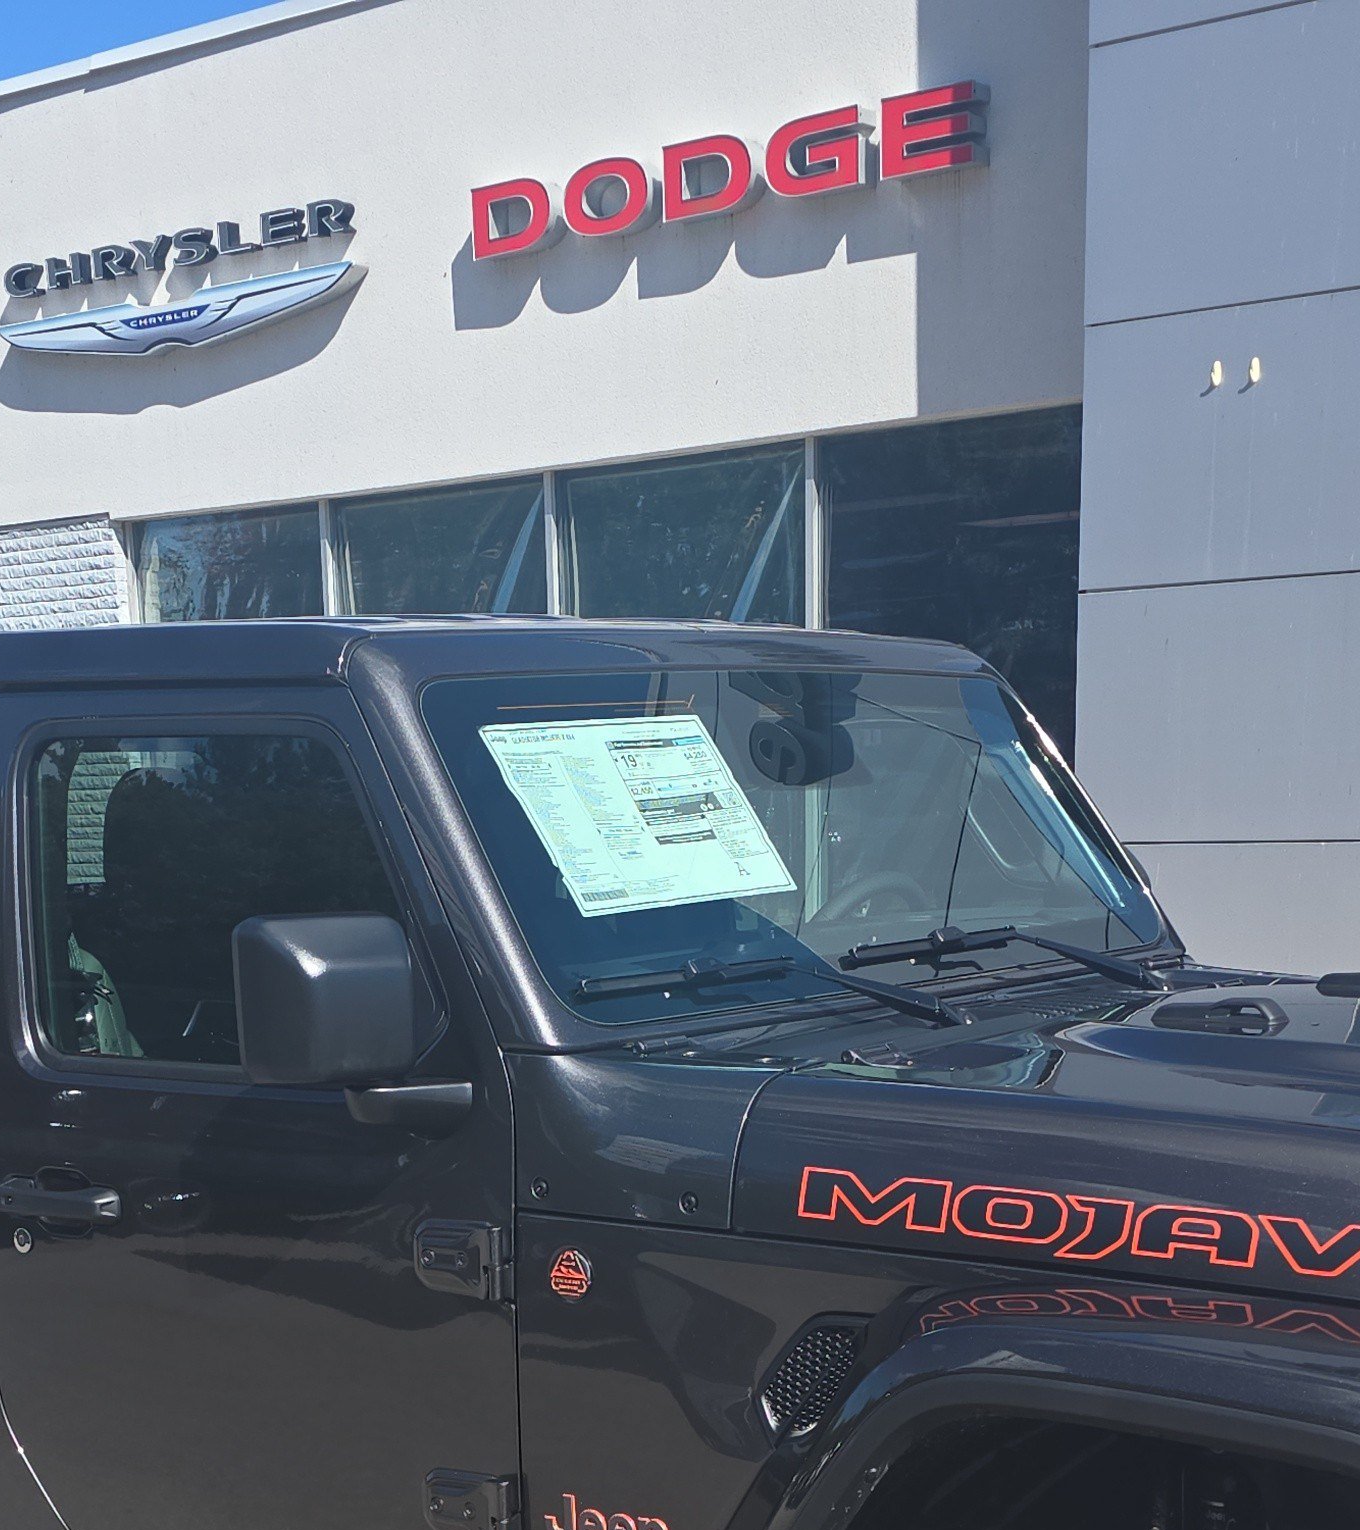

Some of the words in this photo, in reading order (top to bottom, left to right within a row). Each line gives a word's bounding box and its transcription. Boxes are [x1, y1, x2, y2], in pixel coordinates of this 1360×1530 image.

[472, 80, 988, 261] DODGE
[3, 199, 356, 300] CHRYSLER
[128, 308, 200, 329] CHRYSLER
[620, 754, 638, 769] 19
